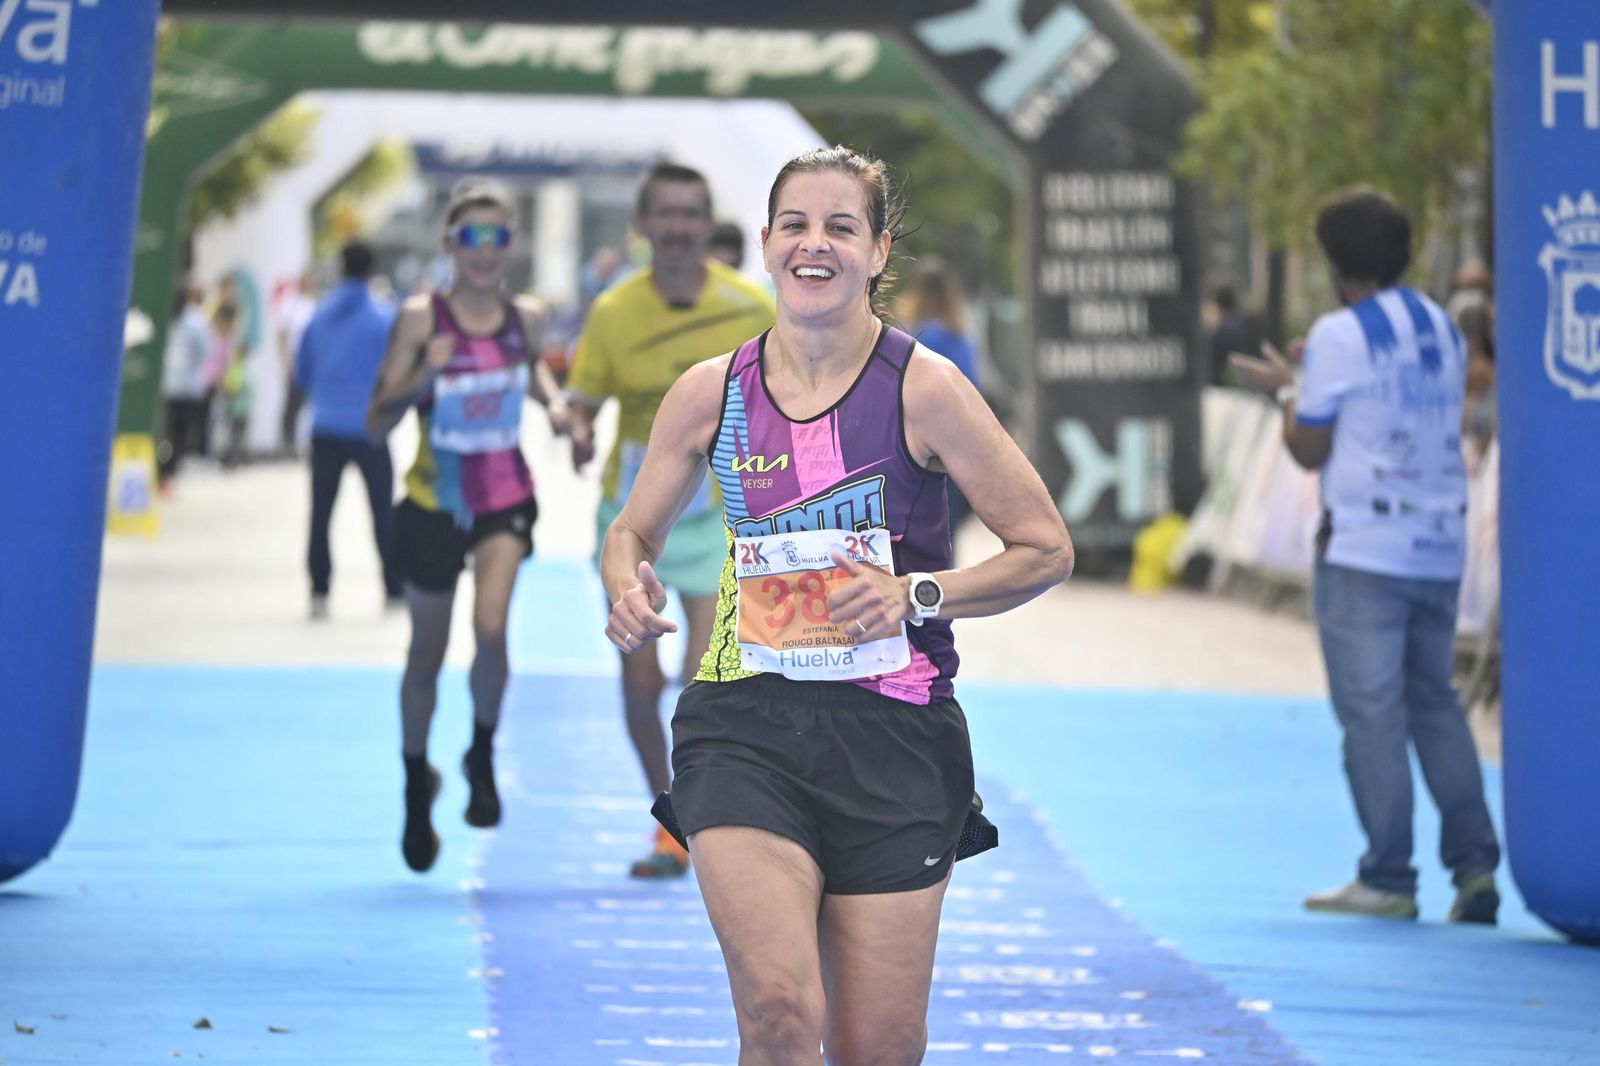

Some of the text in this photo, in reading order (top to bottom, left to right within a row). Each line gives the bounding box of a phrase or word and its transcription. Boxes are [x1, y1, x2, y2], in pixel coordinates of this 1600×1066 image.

[17, 226, 48, 255] de
[742, 478, 774, 489] VEYSER
[739, 542, 769, 565] 2K
[845, 533, 879, 556] 2K
[743, 564, 772, 575] HUELVA
[802, 555, 829, 564] HUELVA
[762, 571, 850, 629] 38
[782, 637, 813, 648] ROUCO
[780, 648, 855, 668] Huelva
